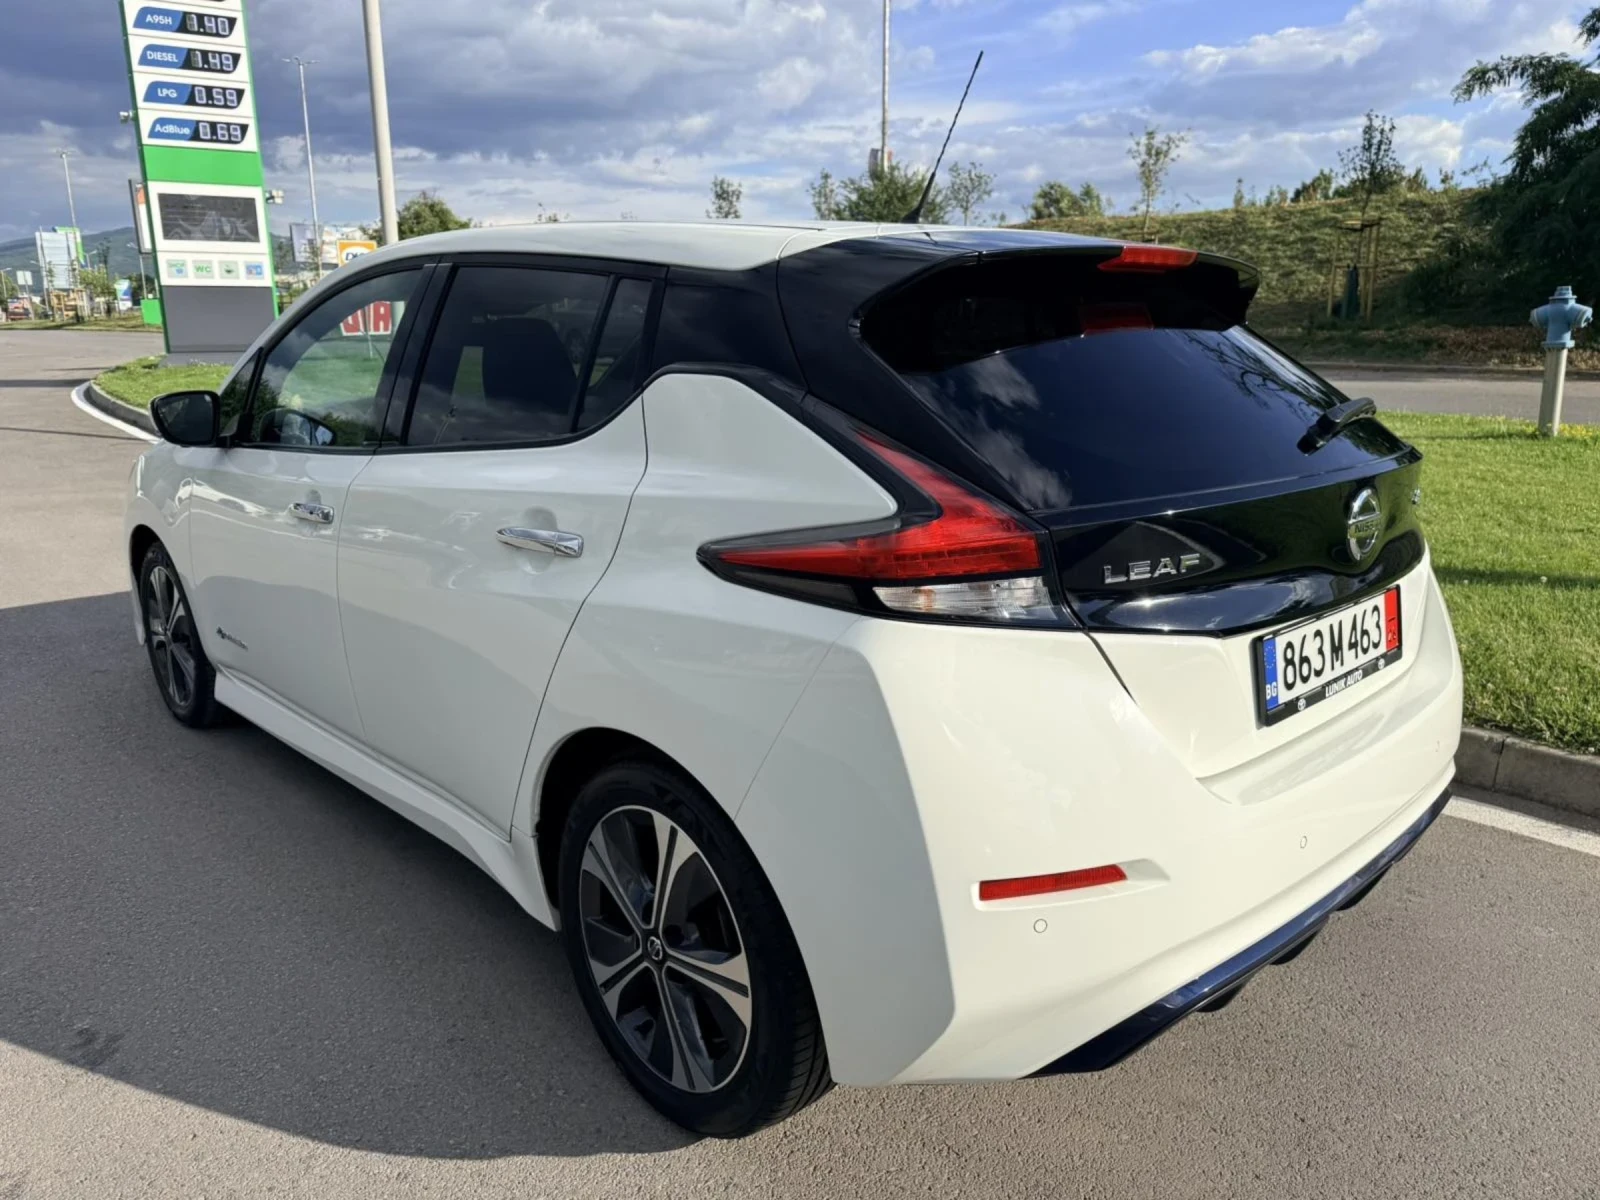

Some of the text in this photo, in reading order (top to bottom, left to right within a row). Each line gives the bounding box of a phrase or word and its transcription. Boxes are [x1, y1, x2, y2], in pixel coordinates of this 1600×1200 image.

[145, 14, 172, 25] A95H
[146, 51, 178, 63] DIESEL
[157, 86, 238, 107] LPG 0.59
[154, 122, 242, 142] AdBlue 0.69
[194, 264, 212, 273] WC
[1103, 553, 1200, 584] LEAF
[1265, 682, 1278, 699] BG
